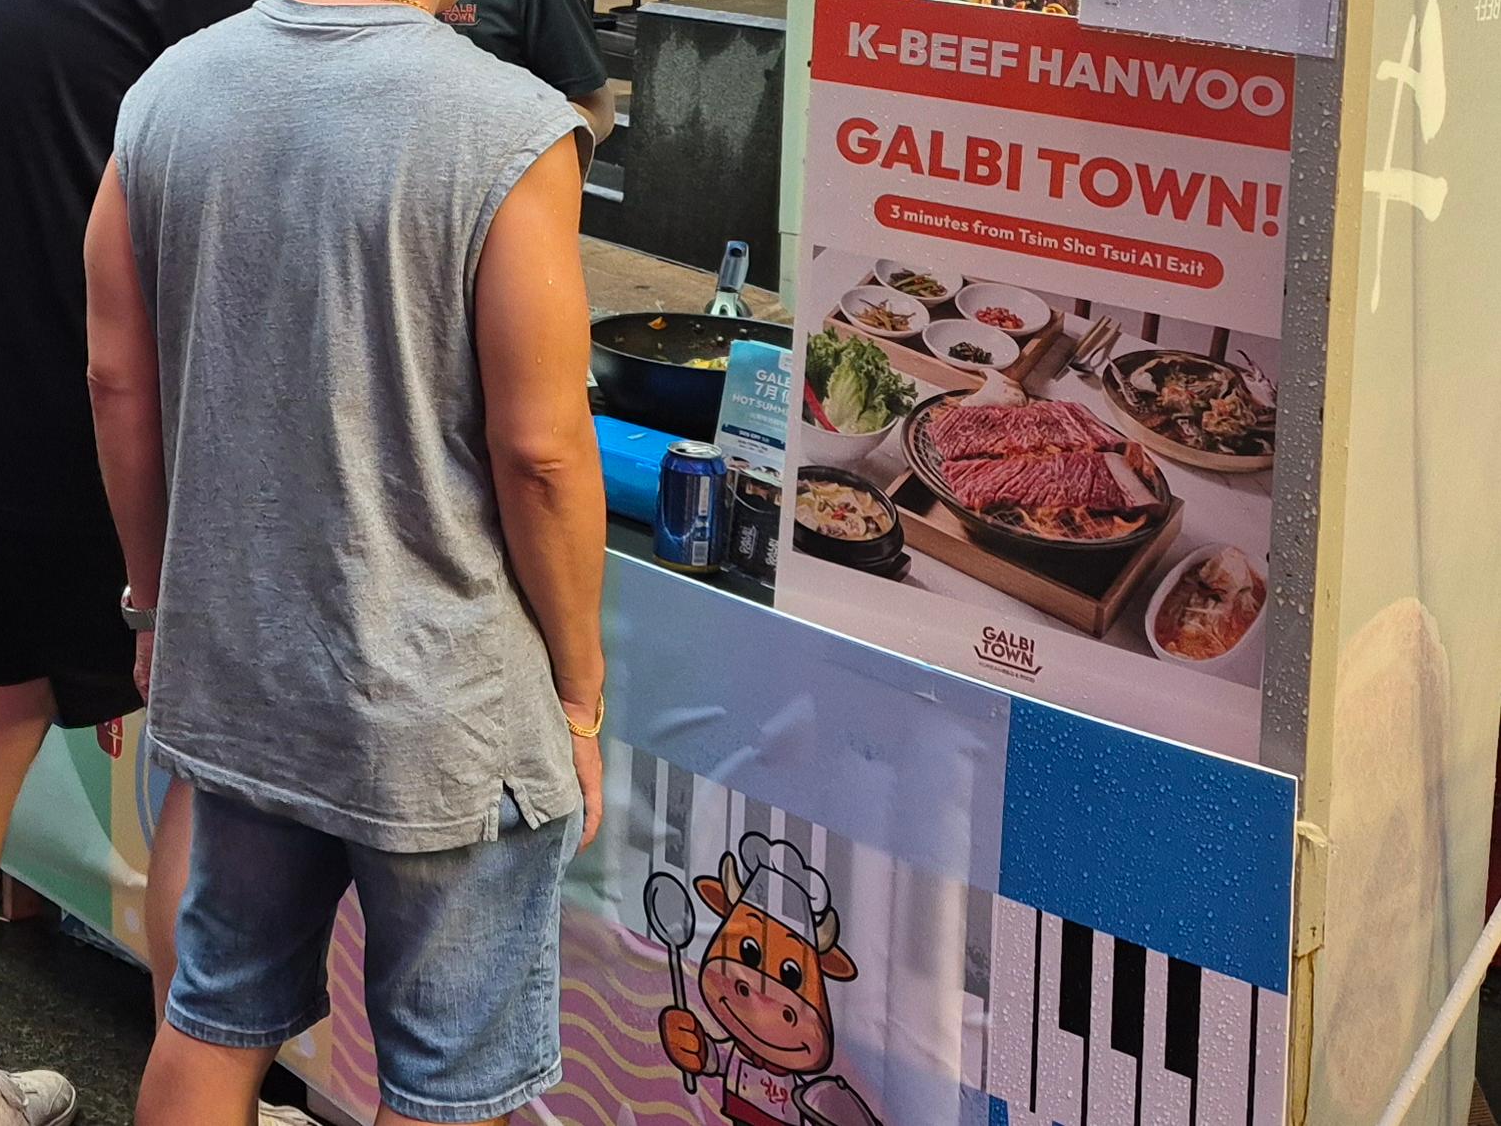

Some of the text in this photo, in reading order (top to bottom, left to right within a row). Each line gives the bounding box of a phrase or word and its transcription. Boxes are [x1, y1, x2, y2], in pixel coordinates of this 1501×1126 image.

[442, 12, 476, 23] TOWN
[848, 22, 1286, 117] K-BEEF HANWOO
[835, 117, 1283, 237] GALBI TOWN!
[890, 204, 1205, 278] 3 minutes from Tsim Sha Tsui A1 Exit
[732, 393, 756, 406] HOT
[982, 626, 1035, 653] GALBI
[982, 639, 1034, 667] TOWN
